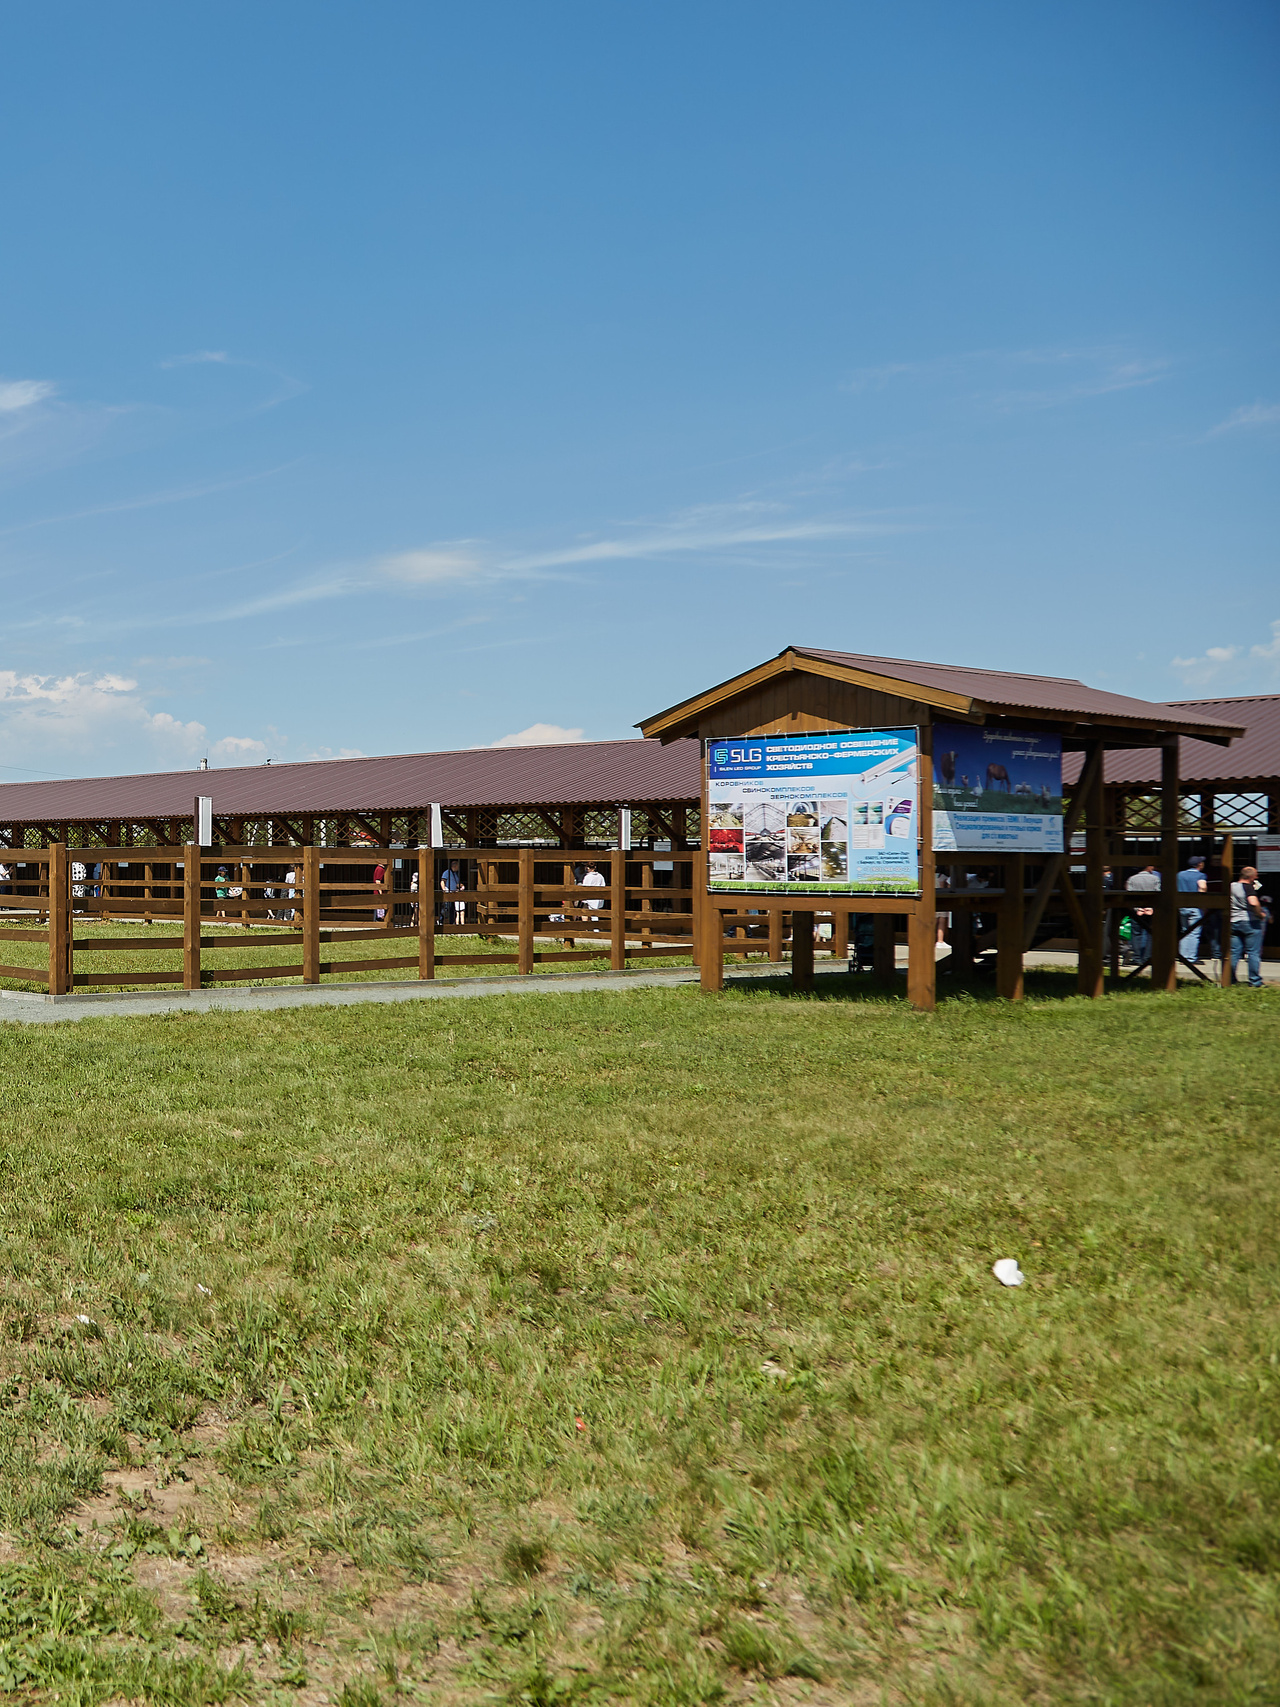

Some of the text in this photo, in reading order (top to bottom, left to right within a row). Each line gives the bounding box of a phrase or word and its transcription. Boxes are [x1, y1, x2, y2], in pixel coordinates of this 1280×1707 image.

[765, 738, 899, 753] СВЕТОДИОДНОЕ ОСВЕЩЕНИЕ
[730, 748, 762, 763] SLG
[765, 748, 900, 762] КРЕСТЬЯНСКО-ФЕРМЕРСКИХ
[765, 762, 814, 772] ХОЗЯЙСТВ
[770, 792, 848, 800] ЗЕРНОКОМПЛЕКСОВ
